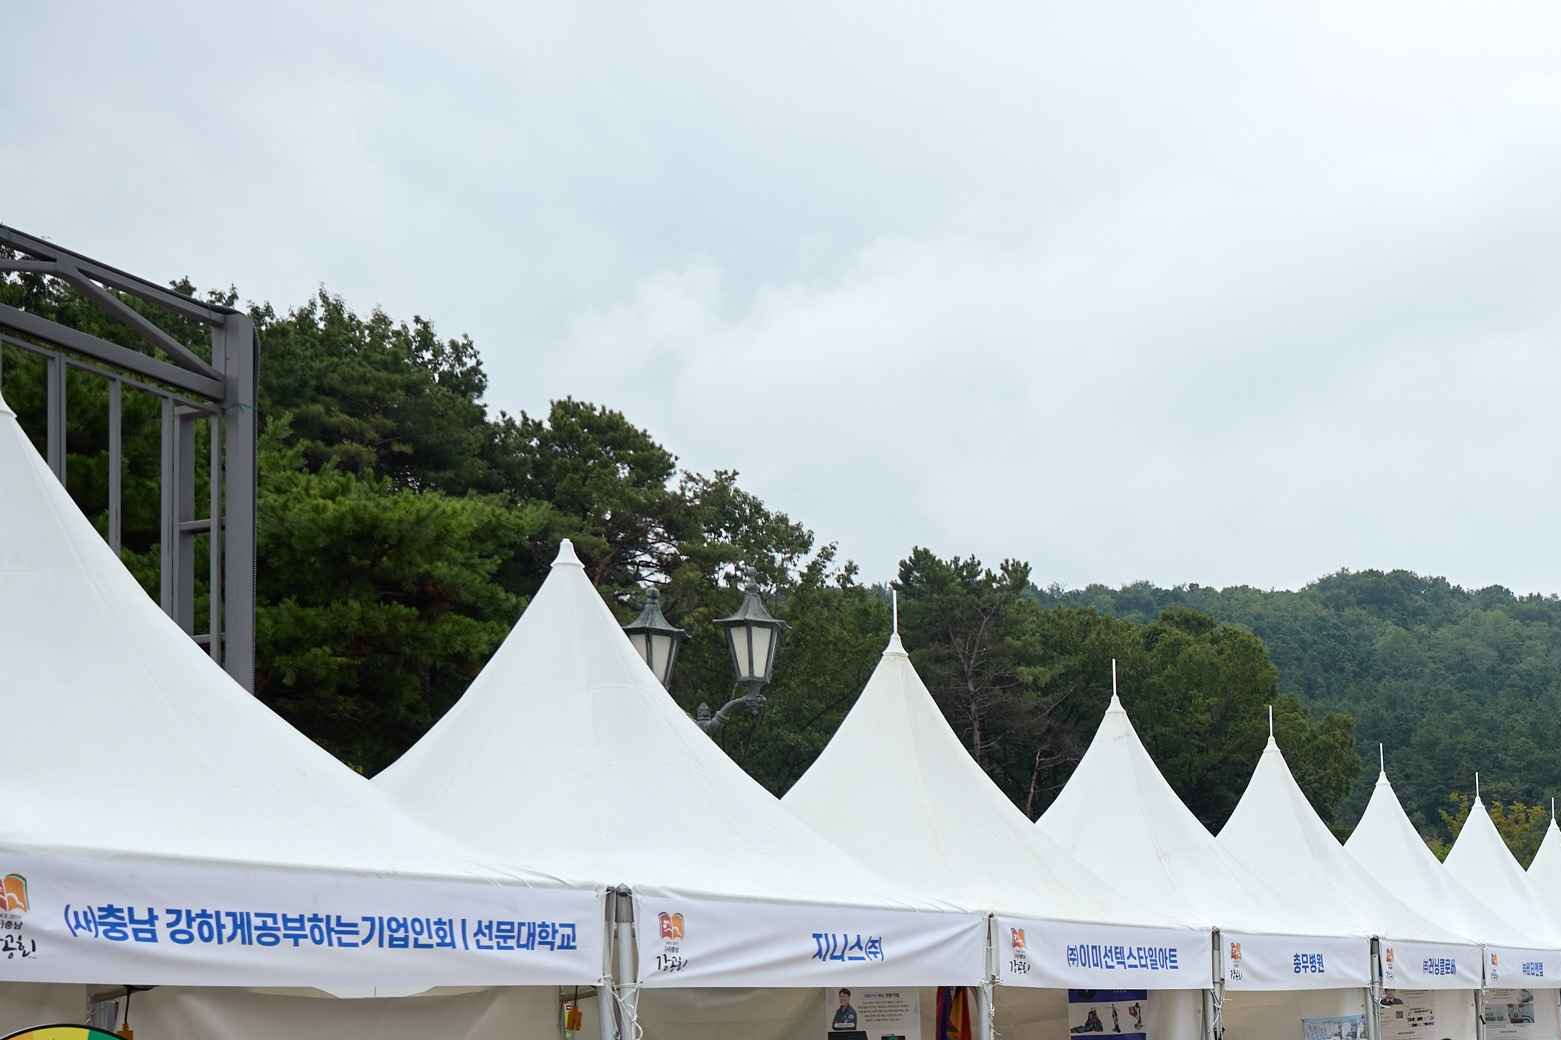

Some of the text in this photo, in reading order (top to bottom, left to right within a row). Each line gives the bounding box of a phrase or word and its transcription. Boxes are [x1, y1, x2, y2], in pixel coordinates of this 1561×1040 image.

[64, 903, 160, 944] (사)충남
[165, 908, 457, 950] 강하게공부하는기업인회
[473, 919, 577, 951] 선문대학교
[811, 932, 884, 962] 지니스(주)
[1292, 952, 1326, 974] 충무병원
